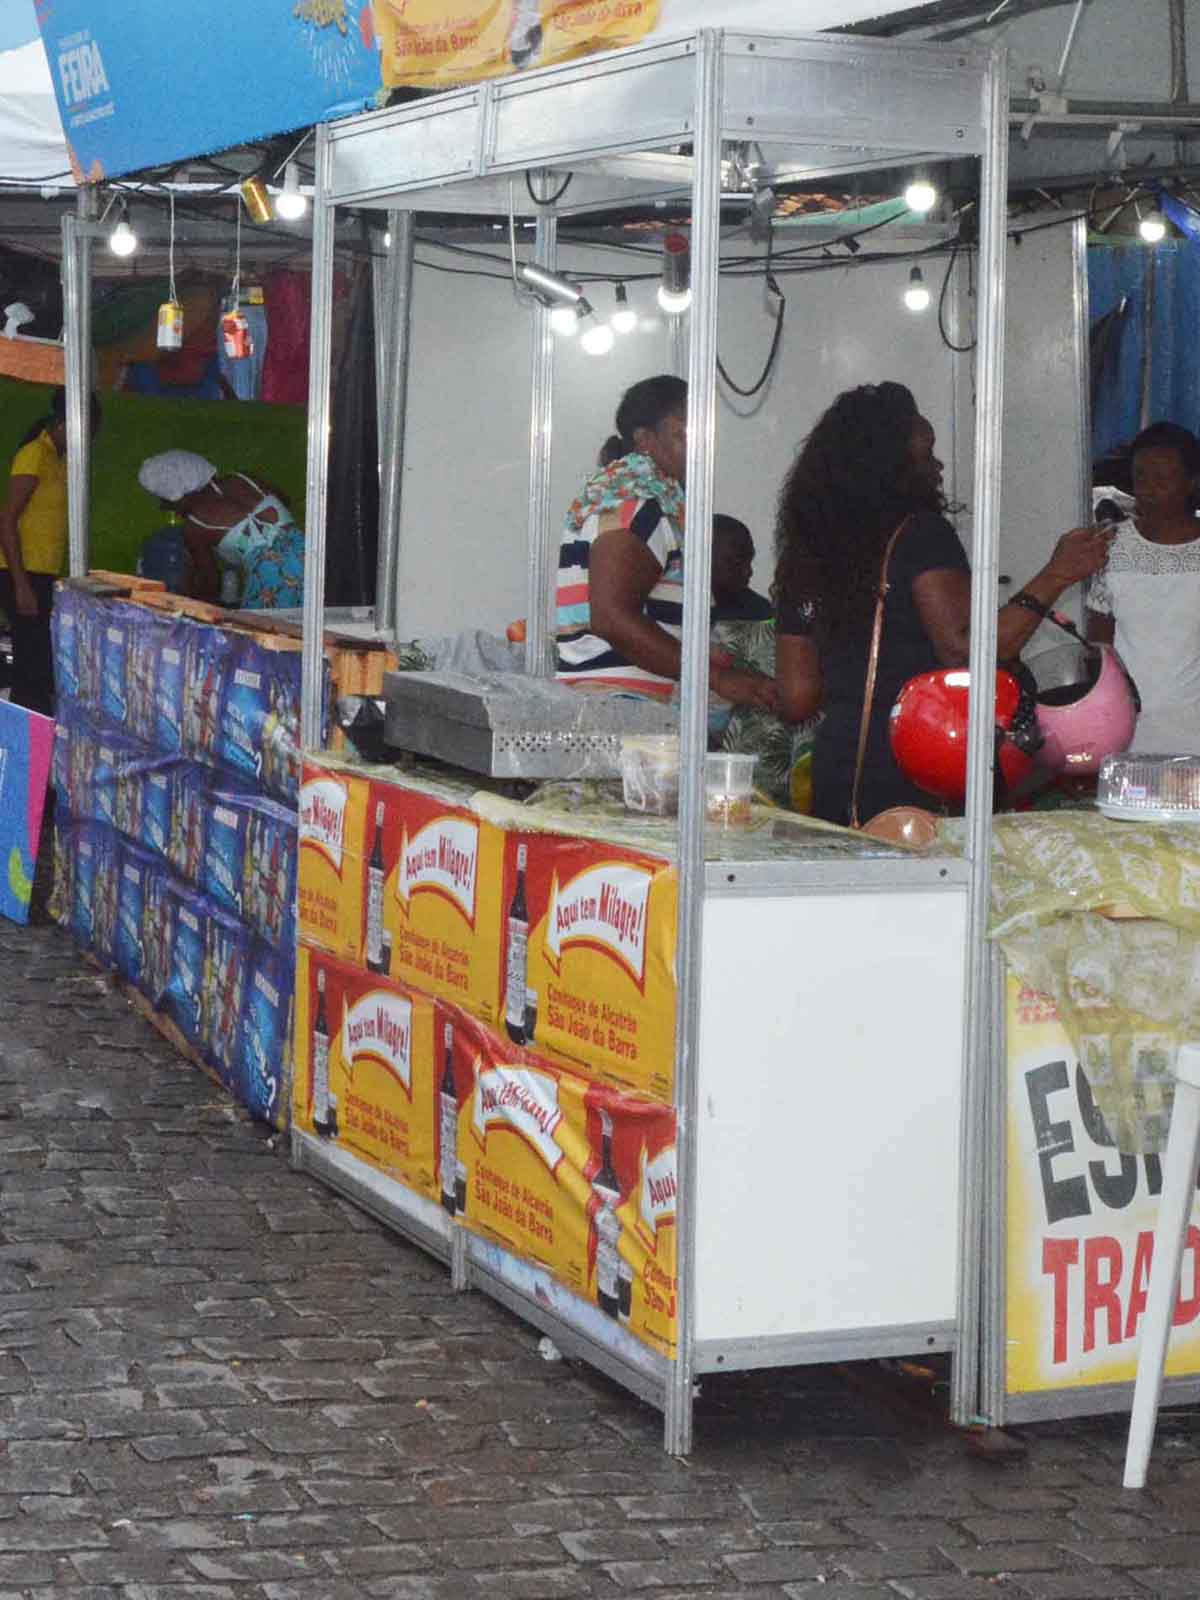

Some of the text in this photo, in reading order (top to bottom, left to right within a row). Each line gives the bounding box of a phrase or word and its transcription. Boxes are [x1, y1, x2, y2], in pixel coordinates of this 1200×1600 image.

[59, 40, 110, 106] FEIRA
[438, 834, 475, 890] Milagre!
[556, 881, 644, 948] Aqui tem Milagre!
[648, 1173, 675, 1208] Aqui
